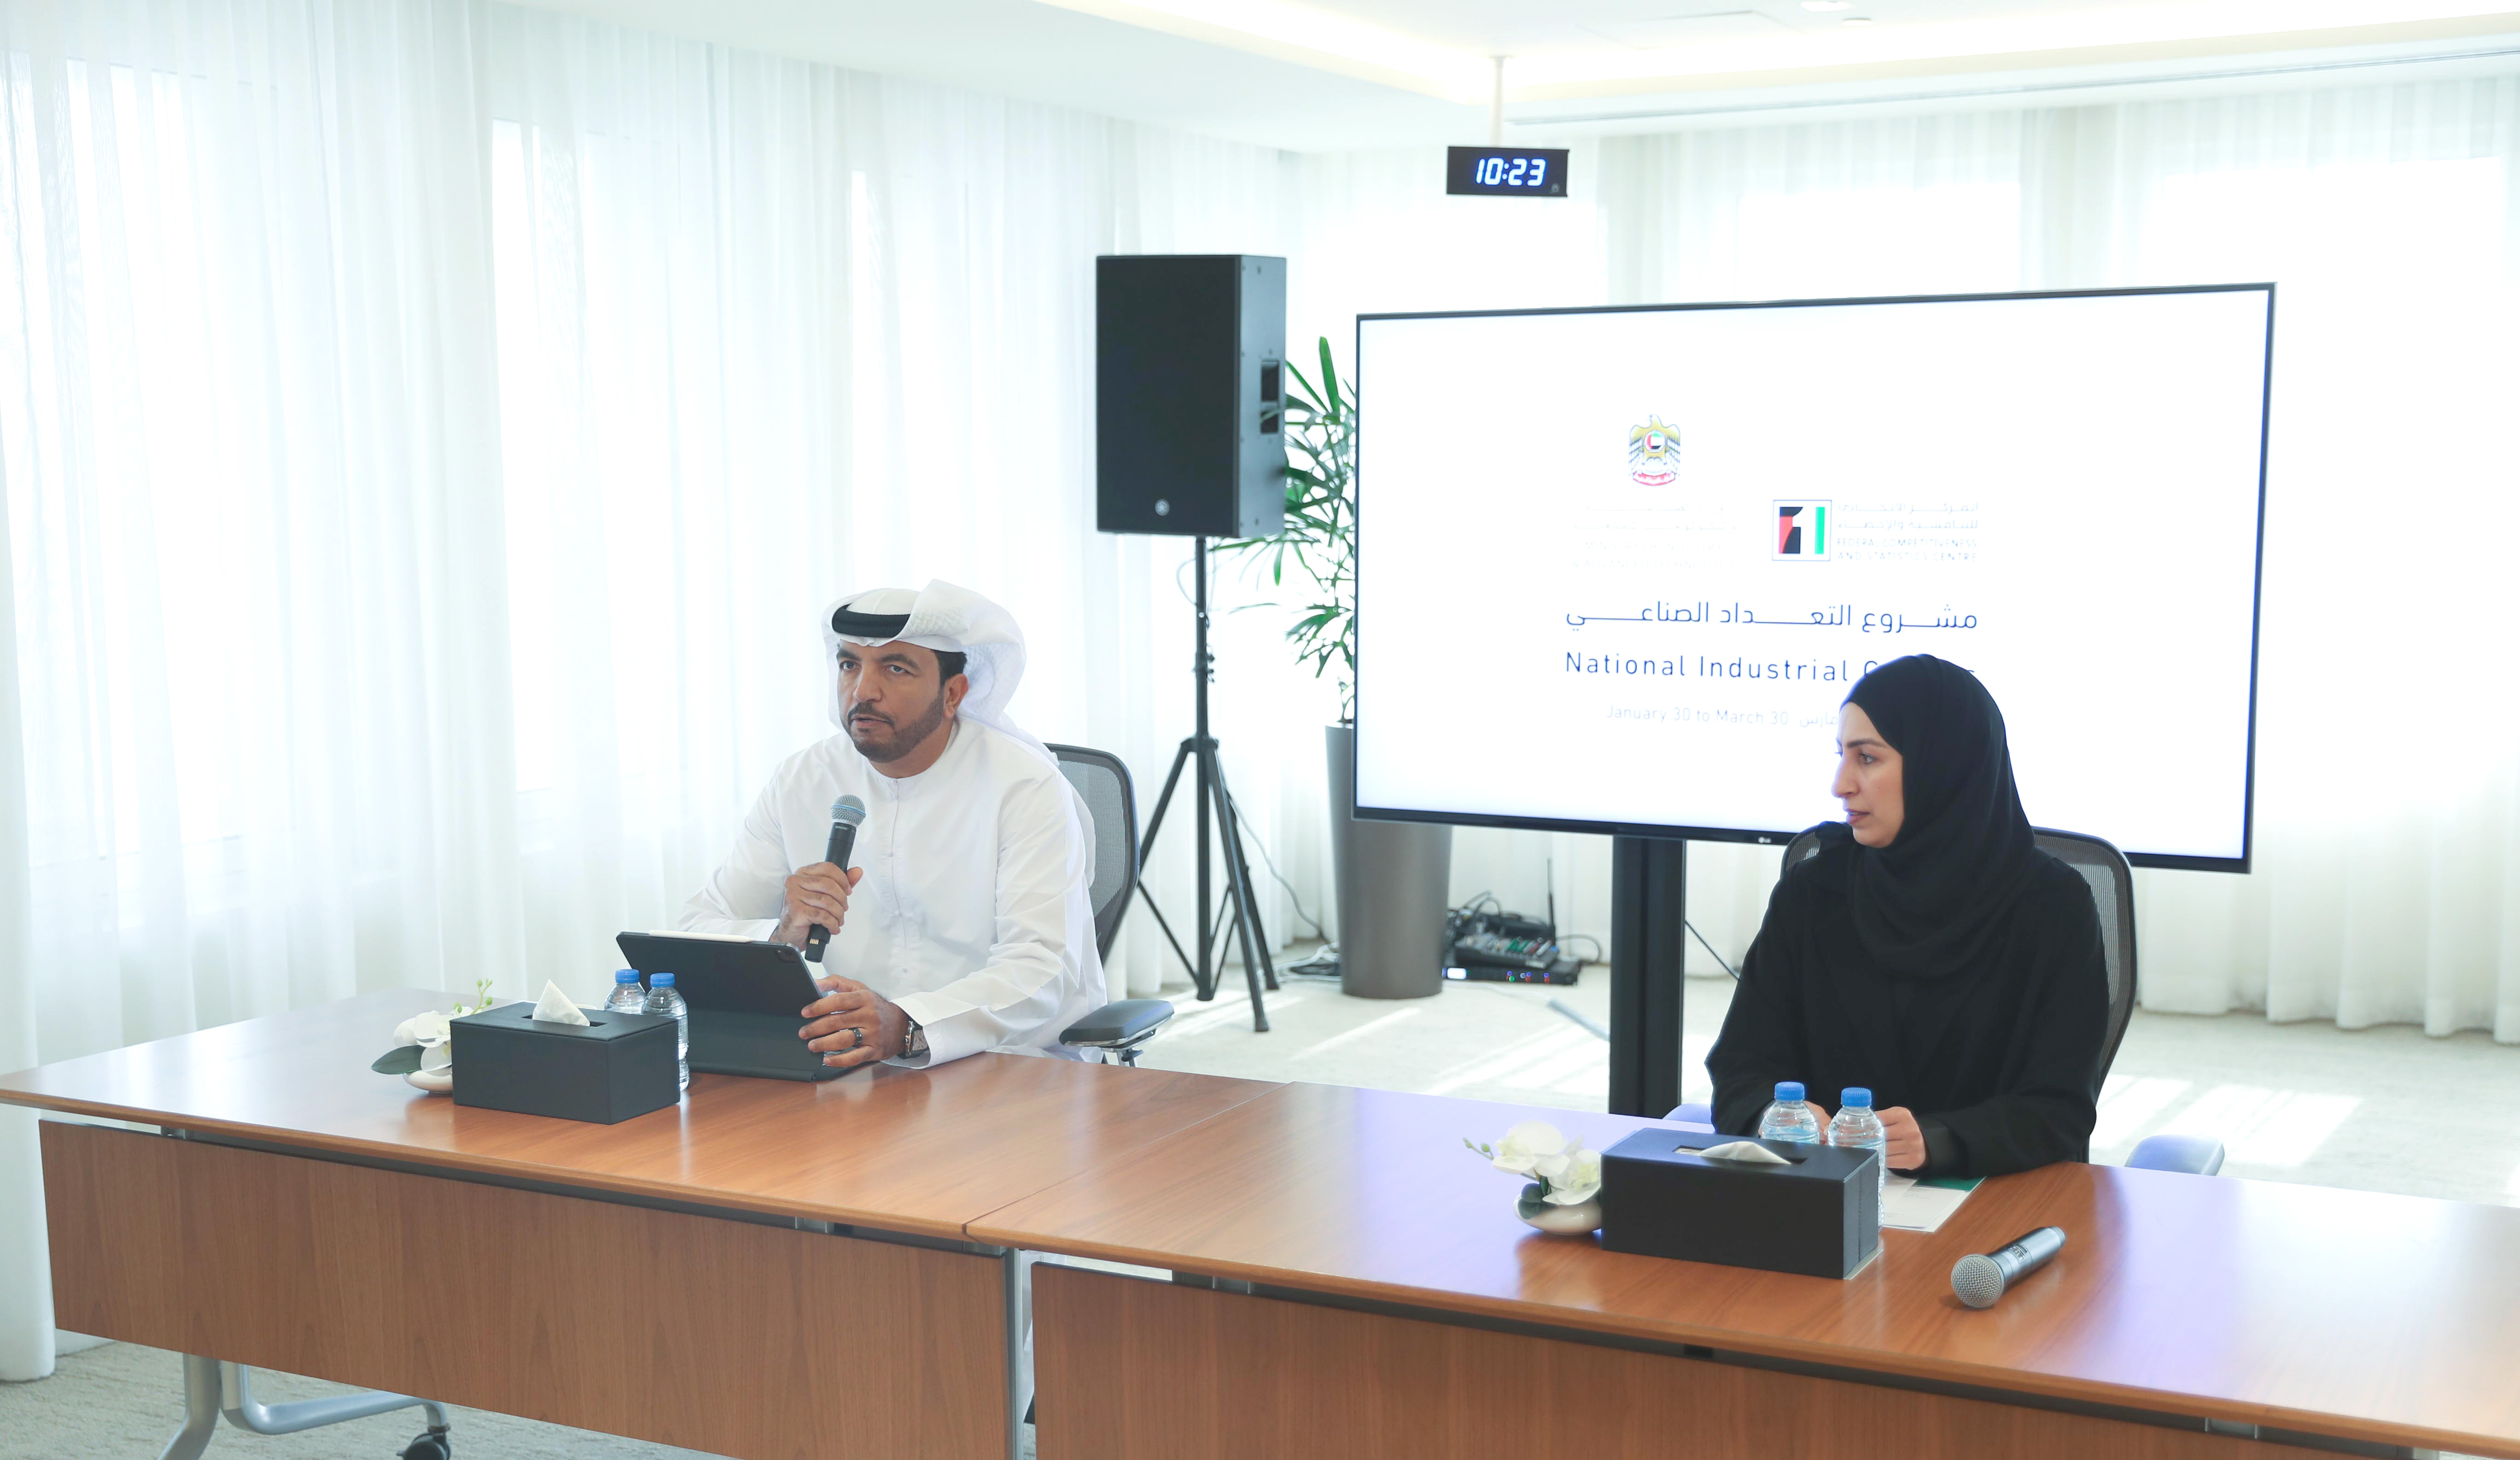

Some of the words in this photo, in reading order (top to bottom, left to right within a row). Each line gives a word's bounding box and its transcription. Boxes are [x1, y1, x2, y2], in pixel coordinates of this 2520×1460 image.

[1476, 157, 1546, 186] 10:23
[1837, 538, 1879, 547] FEDERAL
[1933, 553, 1977, 562] CENTRE
[1566, 652, 1685, 676] National
[1700, 656, 1848, 681] Industrial
[1606, 704, 1668, 723] January
[1673, 707, 1691, 721] 30
[1696, 709, 1710, 722] to
[1716, 709, 1764, 724] March
[1771, 711, 1788, 726] 30
